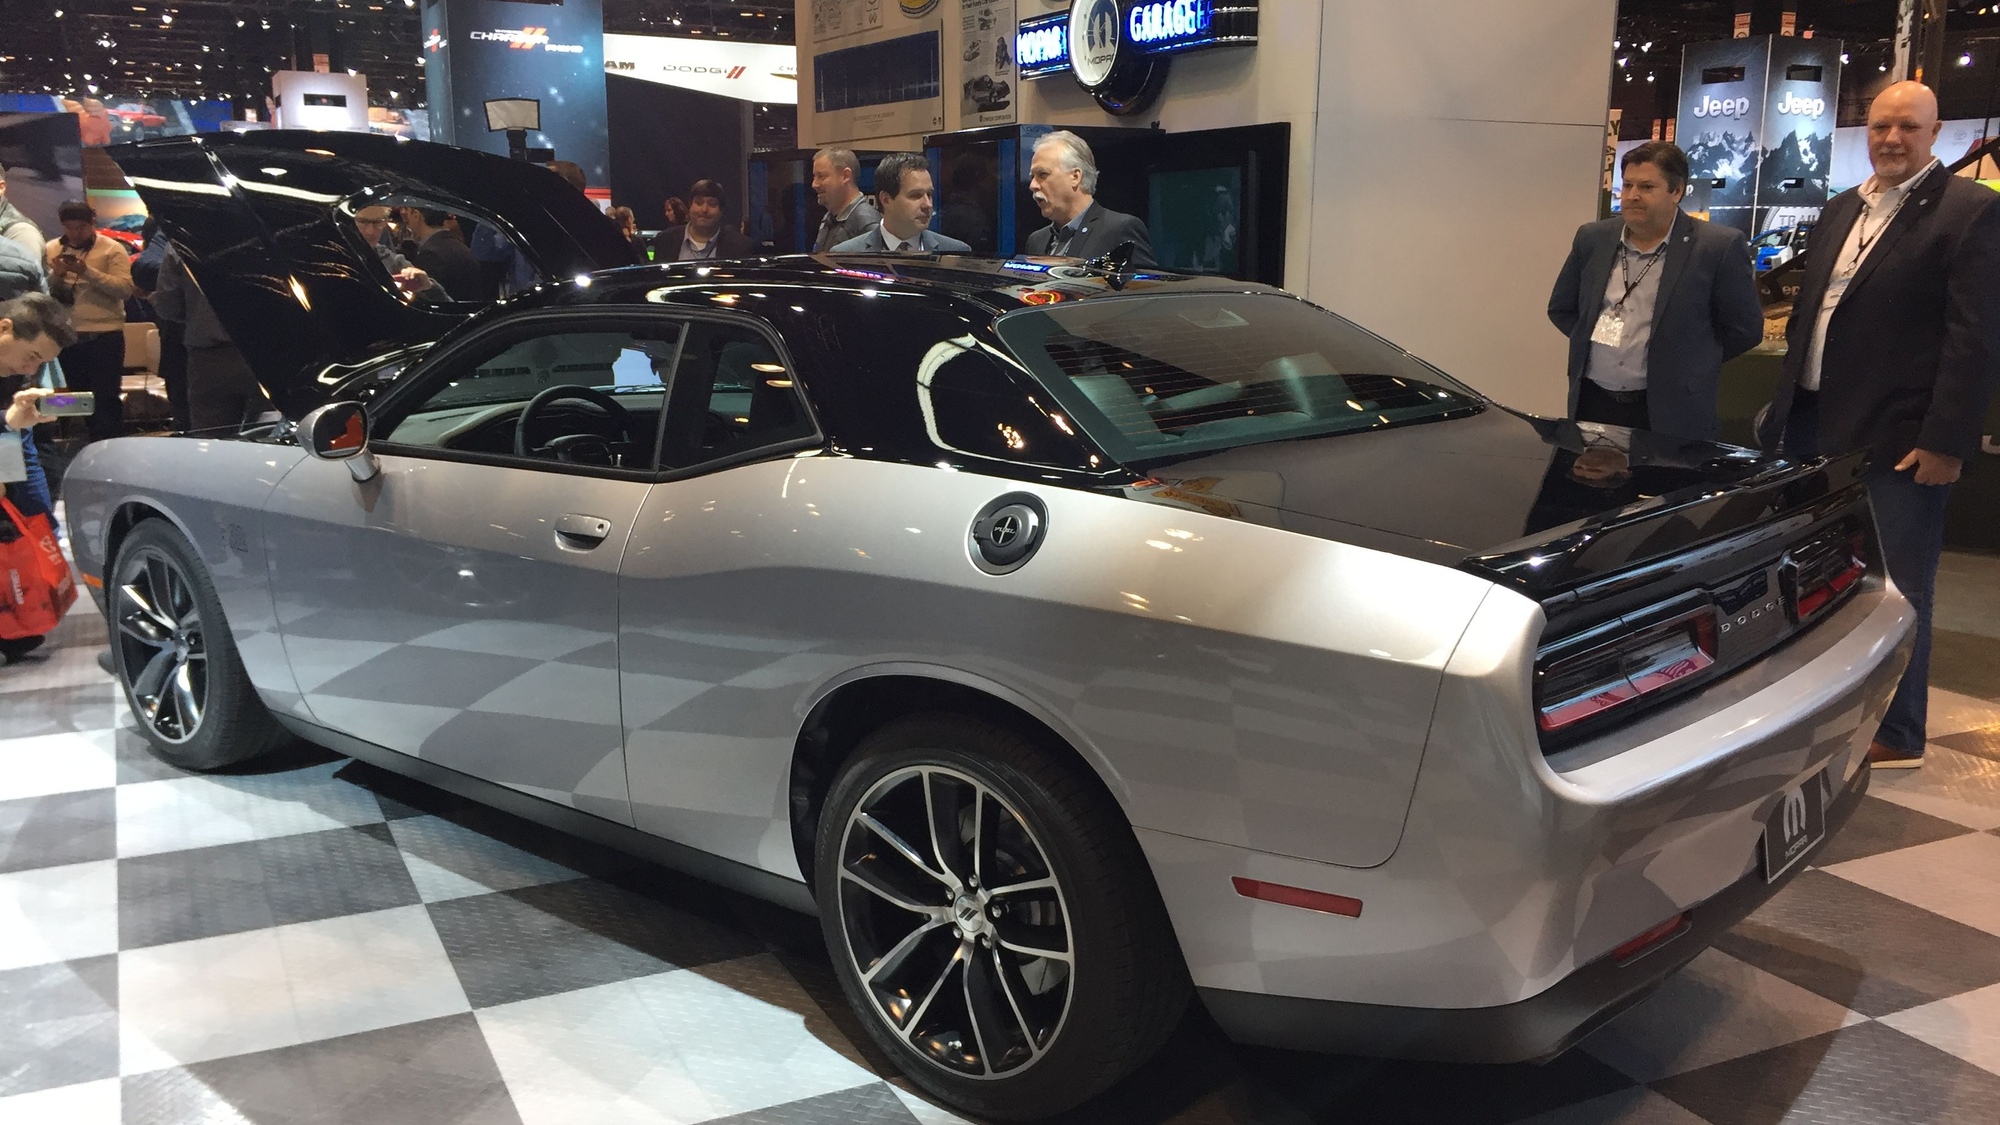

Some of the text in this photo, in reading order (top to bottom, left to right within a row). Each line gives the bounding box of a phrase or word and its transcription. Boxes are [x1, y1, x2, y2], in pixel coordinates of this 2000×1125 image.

[470, 31, 550, 45] CHARR
[1016, 0, 1197, 64] MOPAR GARAGE
[1694, 95, 1750, 120] Jeep
[1778, 91, 1825, 119] Jeep
[1721, 596, 1785, 633] DODGE
[1785, 834, 1808, 860] MOPAR
